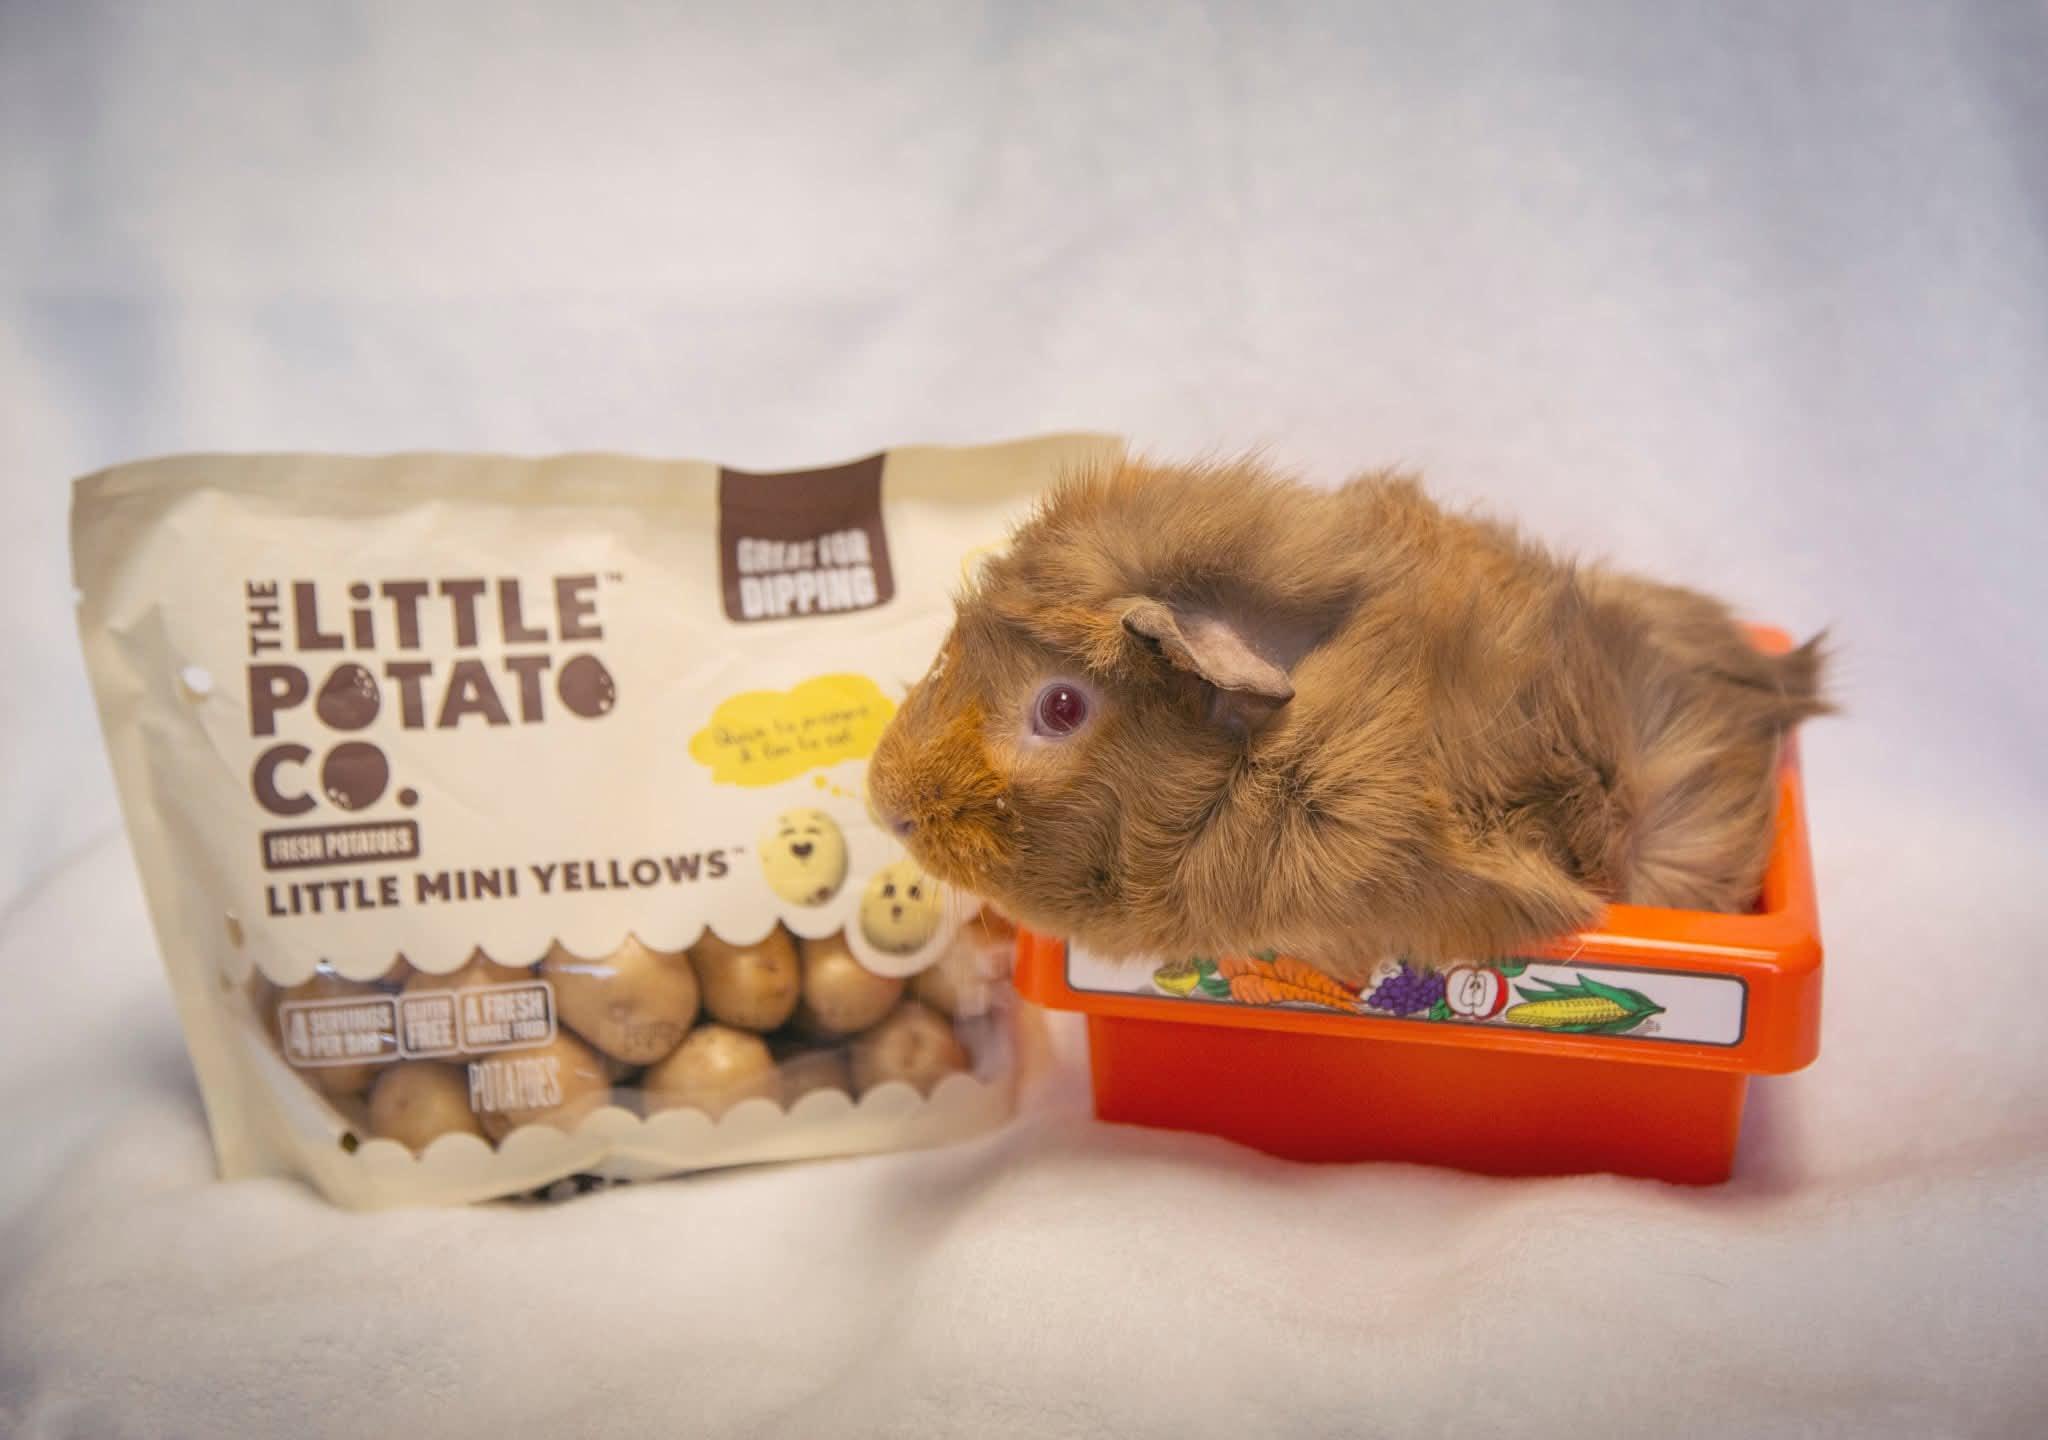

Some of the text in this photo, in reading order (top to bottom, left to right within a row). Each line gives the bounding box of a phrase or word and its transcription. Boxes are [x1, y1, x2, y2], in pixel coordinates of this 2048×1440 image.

[740, 566, 877, 619] DIPPING
[247, 580, 281, 655] THE
[247, 653, 616, 737] POTATO
[269, 828, 411, 864] FRESH POTATOES
[265, 850, 730, 916] LITTLE MINI YELLOWS
[309, 1004, 391, 1036] SERVINGS
[464, 990, 546, 1024] A FRESH
[311, 1034, 342, 1057] PER
[407, 1020, 453, 1050] FREE
[468, 1057, 562, 1112] POTATOES
